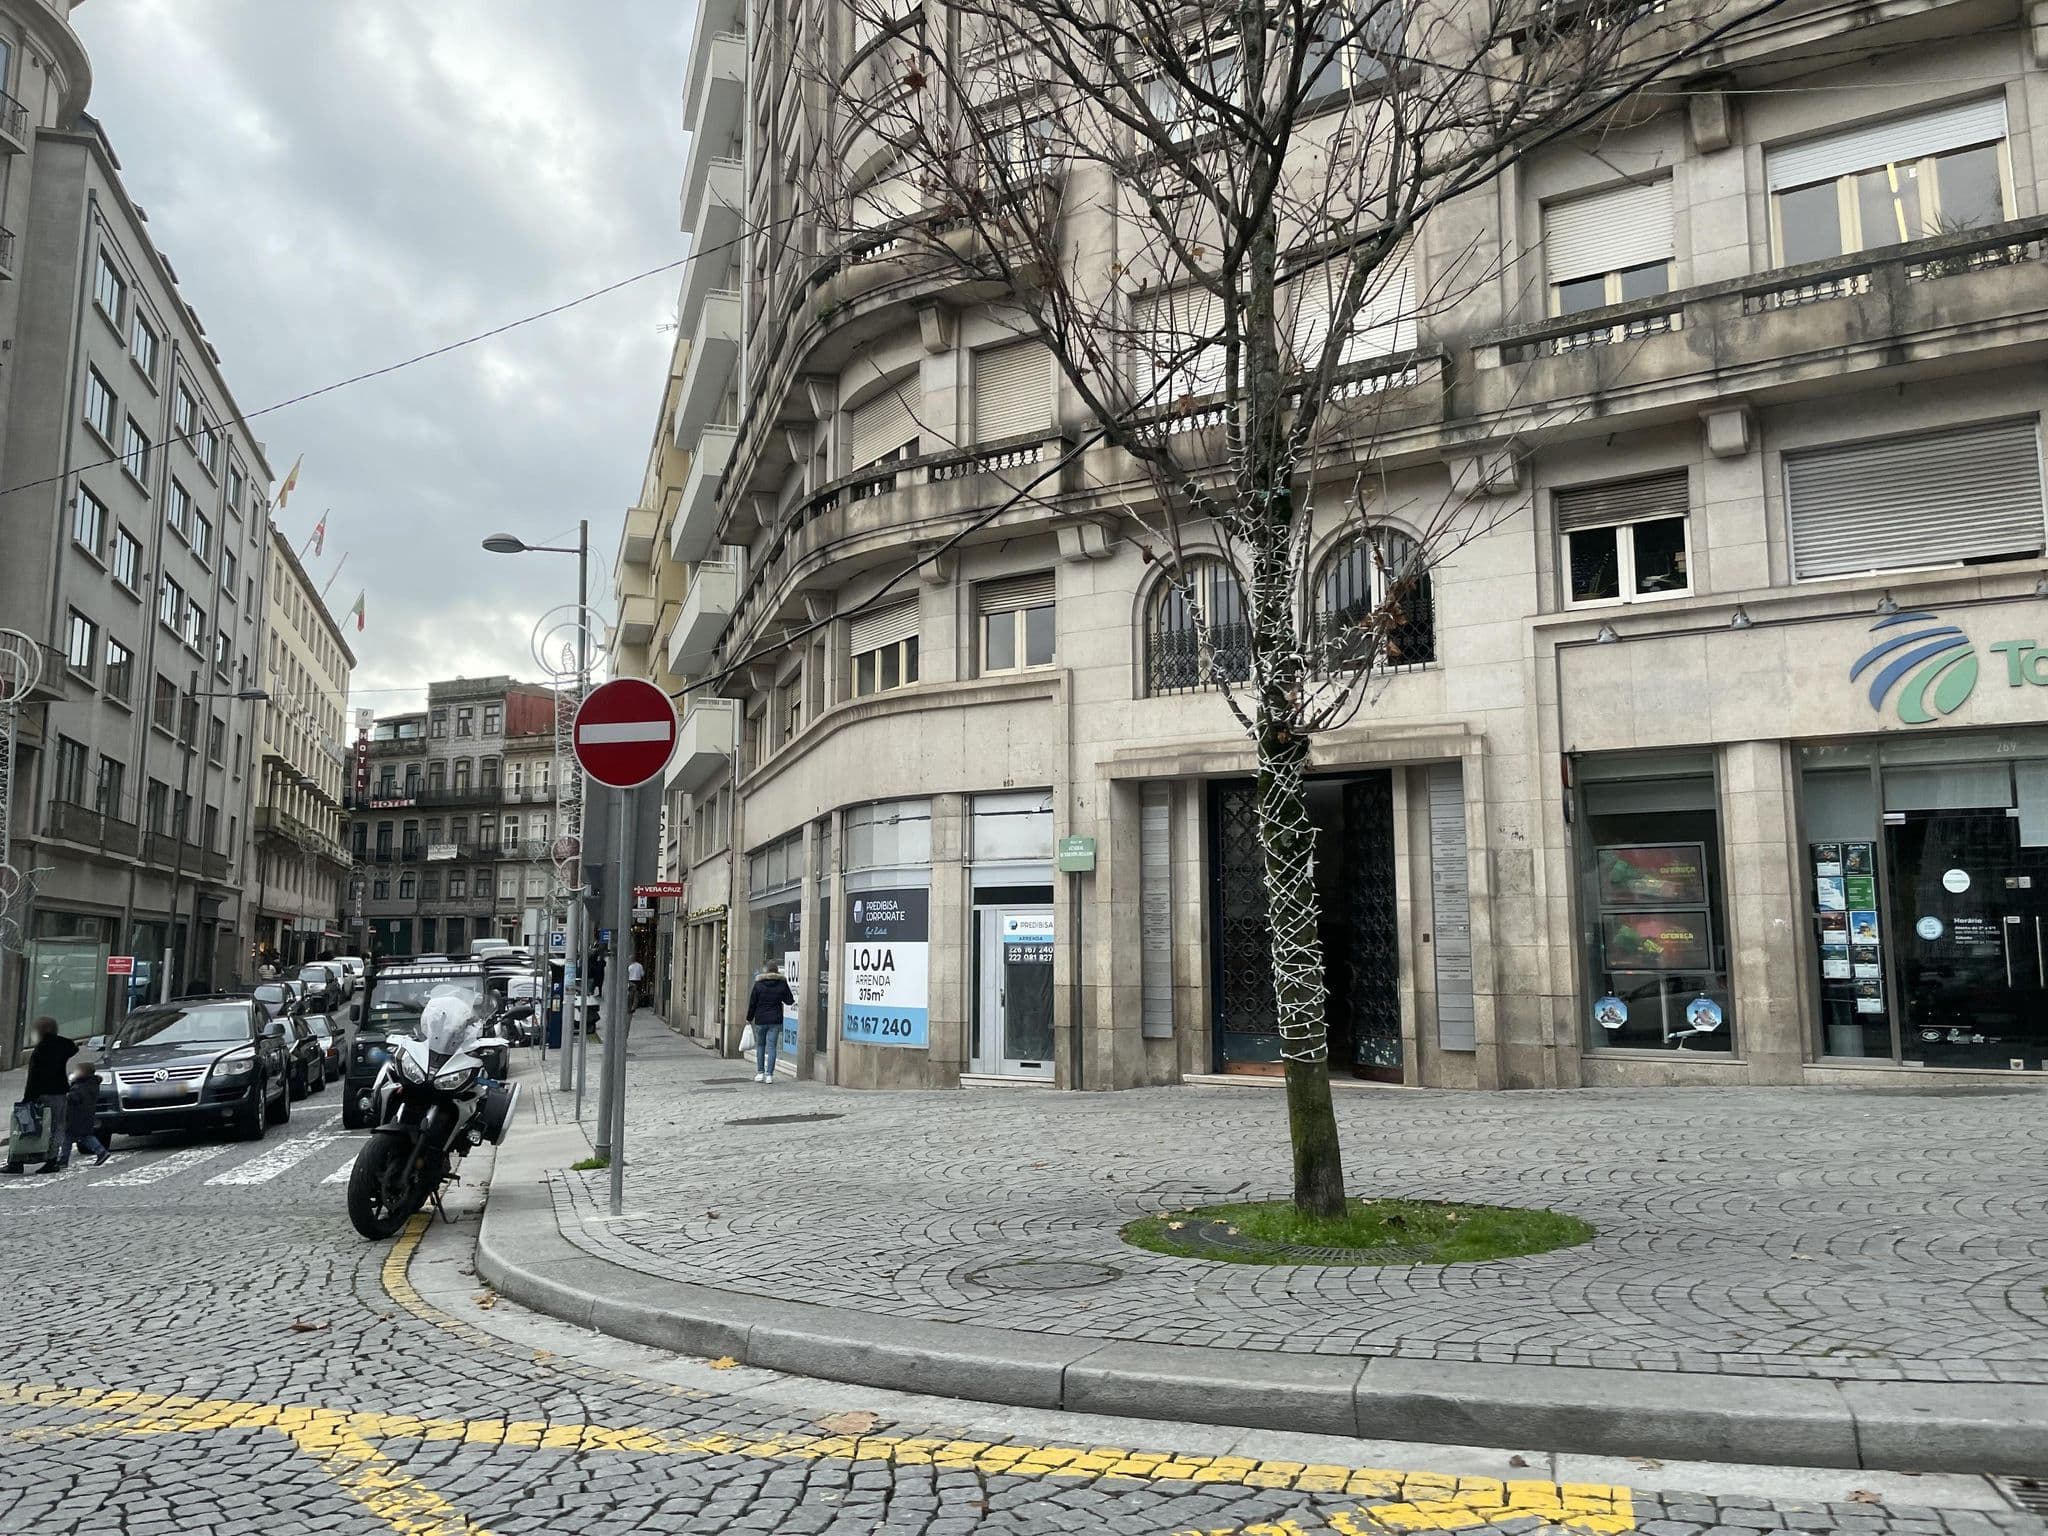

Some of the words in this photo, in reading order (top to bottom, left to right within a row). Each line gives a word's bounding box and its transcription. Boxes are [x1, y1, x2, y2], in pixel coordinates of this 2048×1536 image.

[357, 732, 367, 788] HOTEL
[866, 901, 898, 911] PREDIBISA
[866, 911, 906, 921] CORPORATE
[1020, 921, 1054, 929] PREDIBISA
[552, 934, 562, 946] P
[853, 948, 895, 972] LOJA
[788, 960, 799, 983] LOJ
[855, 974, 891, 987] ARRENDA
[860, 1016, 879, 1035] 167
[881, 1017, 912, 1037] 240
